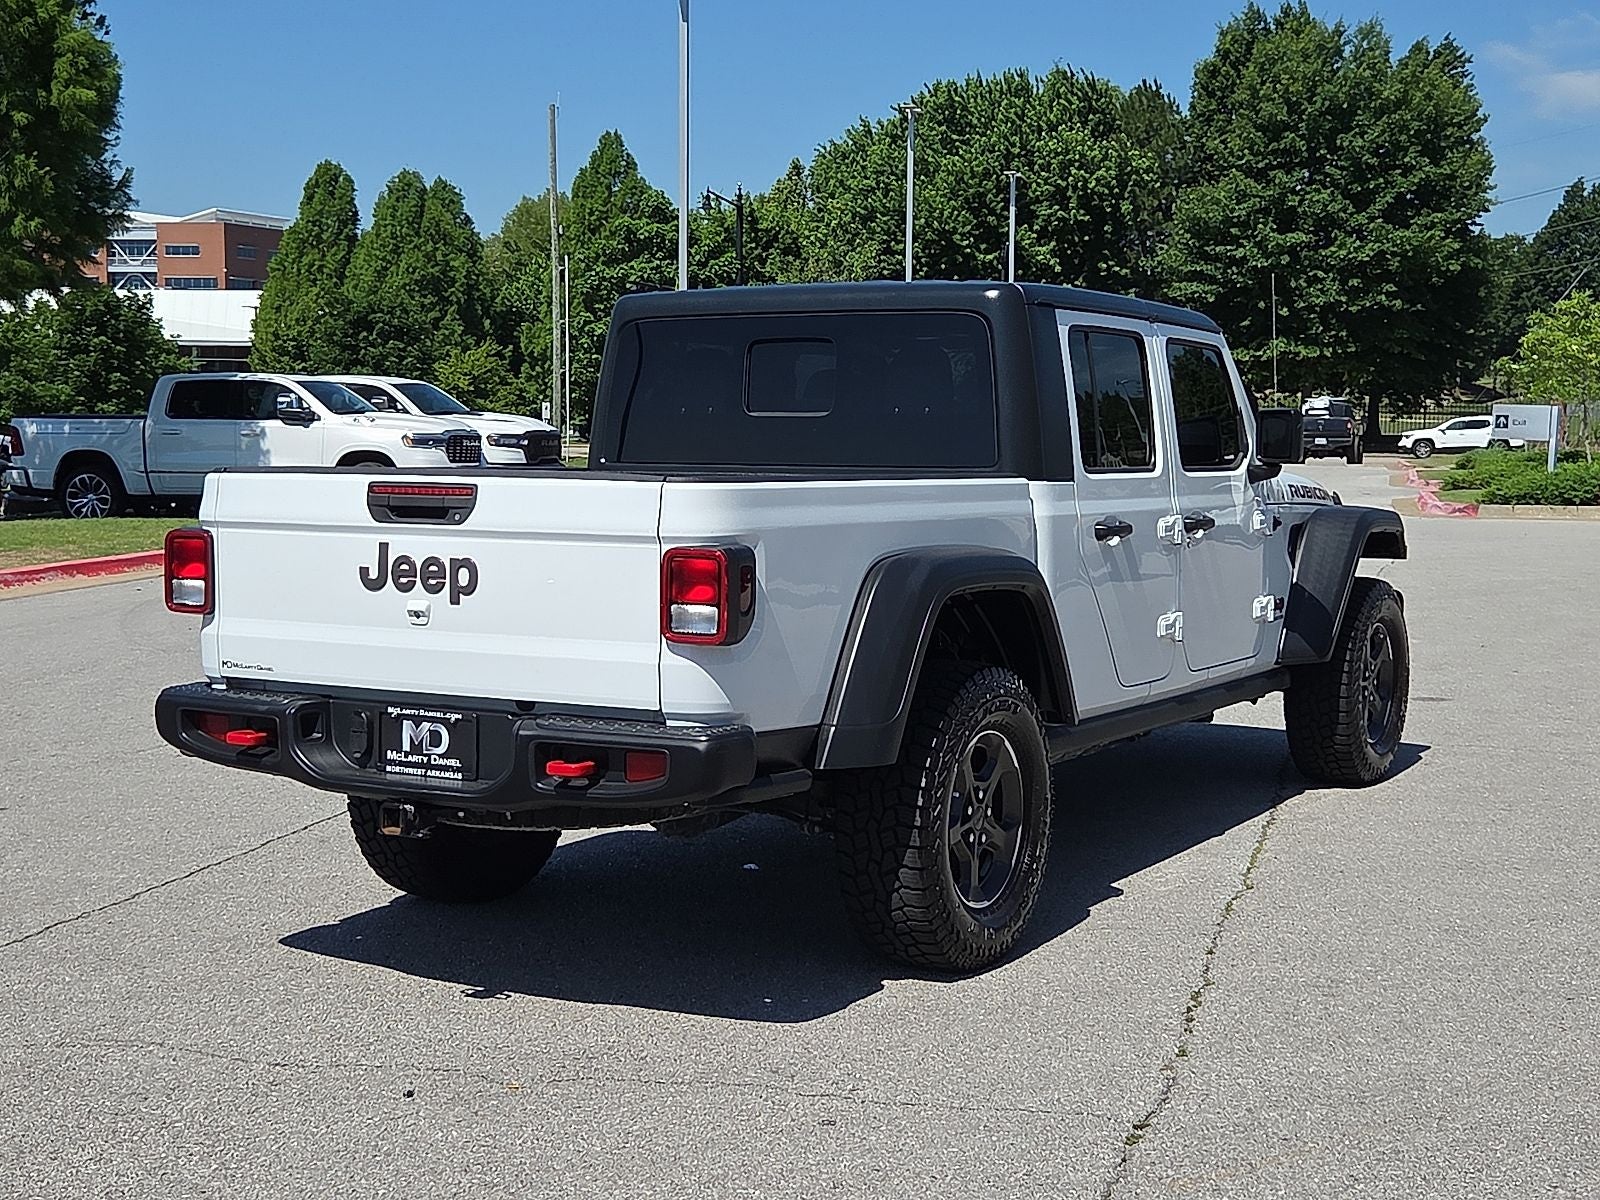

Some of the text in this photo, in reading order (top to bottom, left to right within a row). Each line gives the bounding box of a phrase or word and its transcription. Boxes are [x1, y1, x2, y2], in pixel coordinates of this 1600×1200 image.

[359, 542, 479, 605] Jeep
[430, 755, 462, 766] DANIEL
[386, 765, 462, 779] NORTHWEST ARKANSAS
